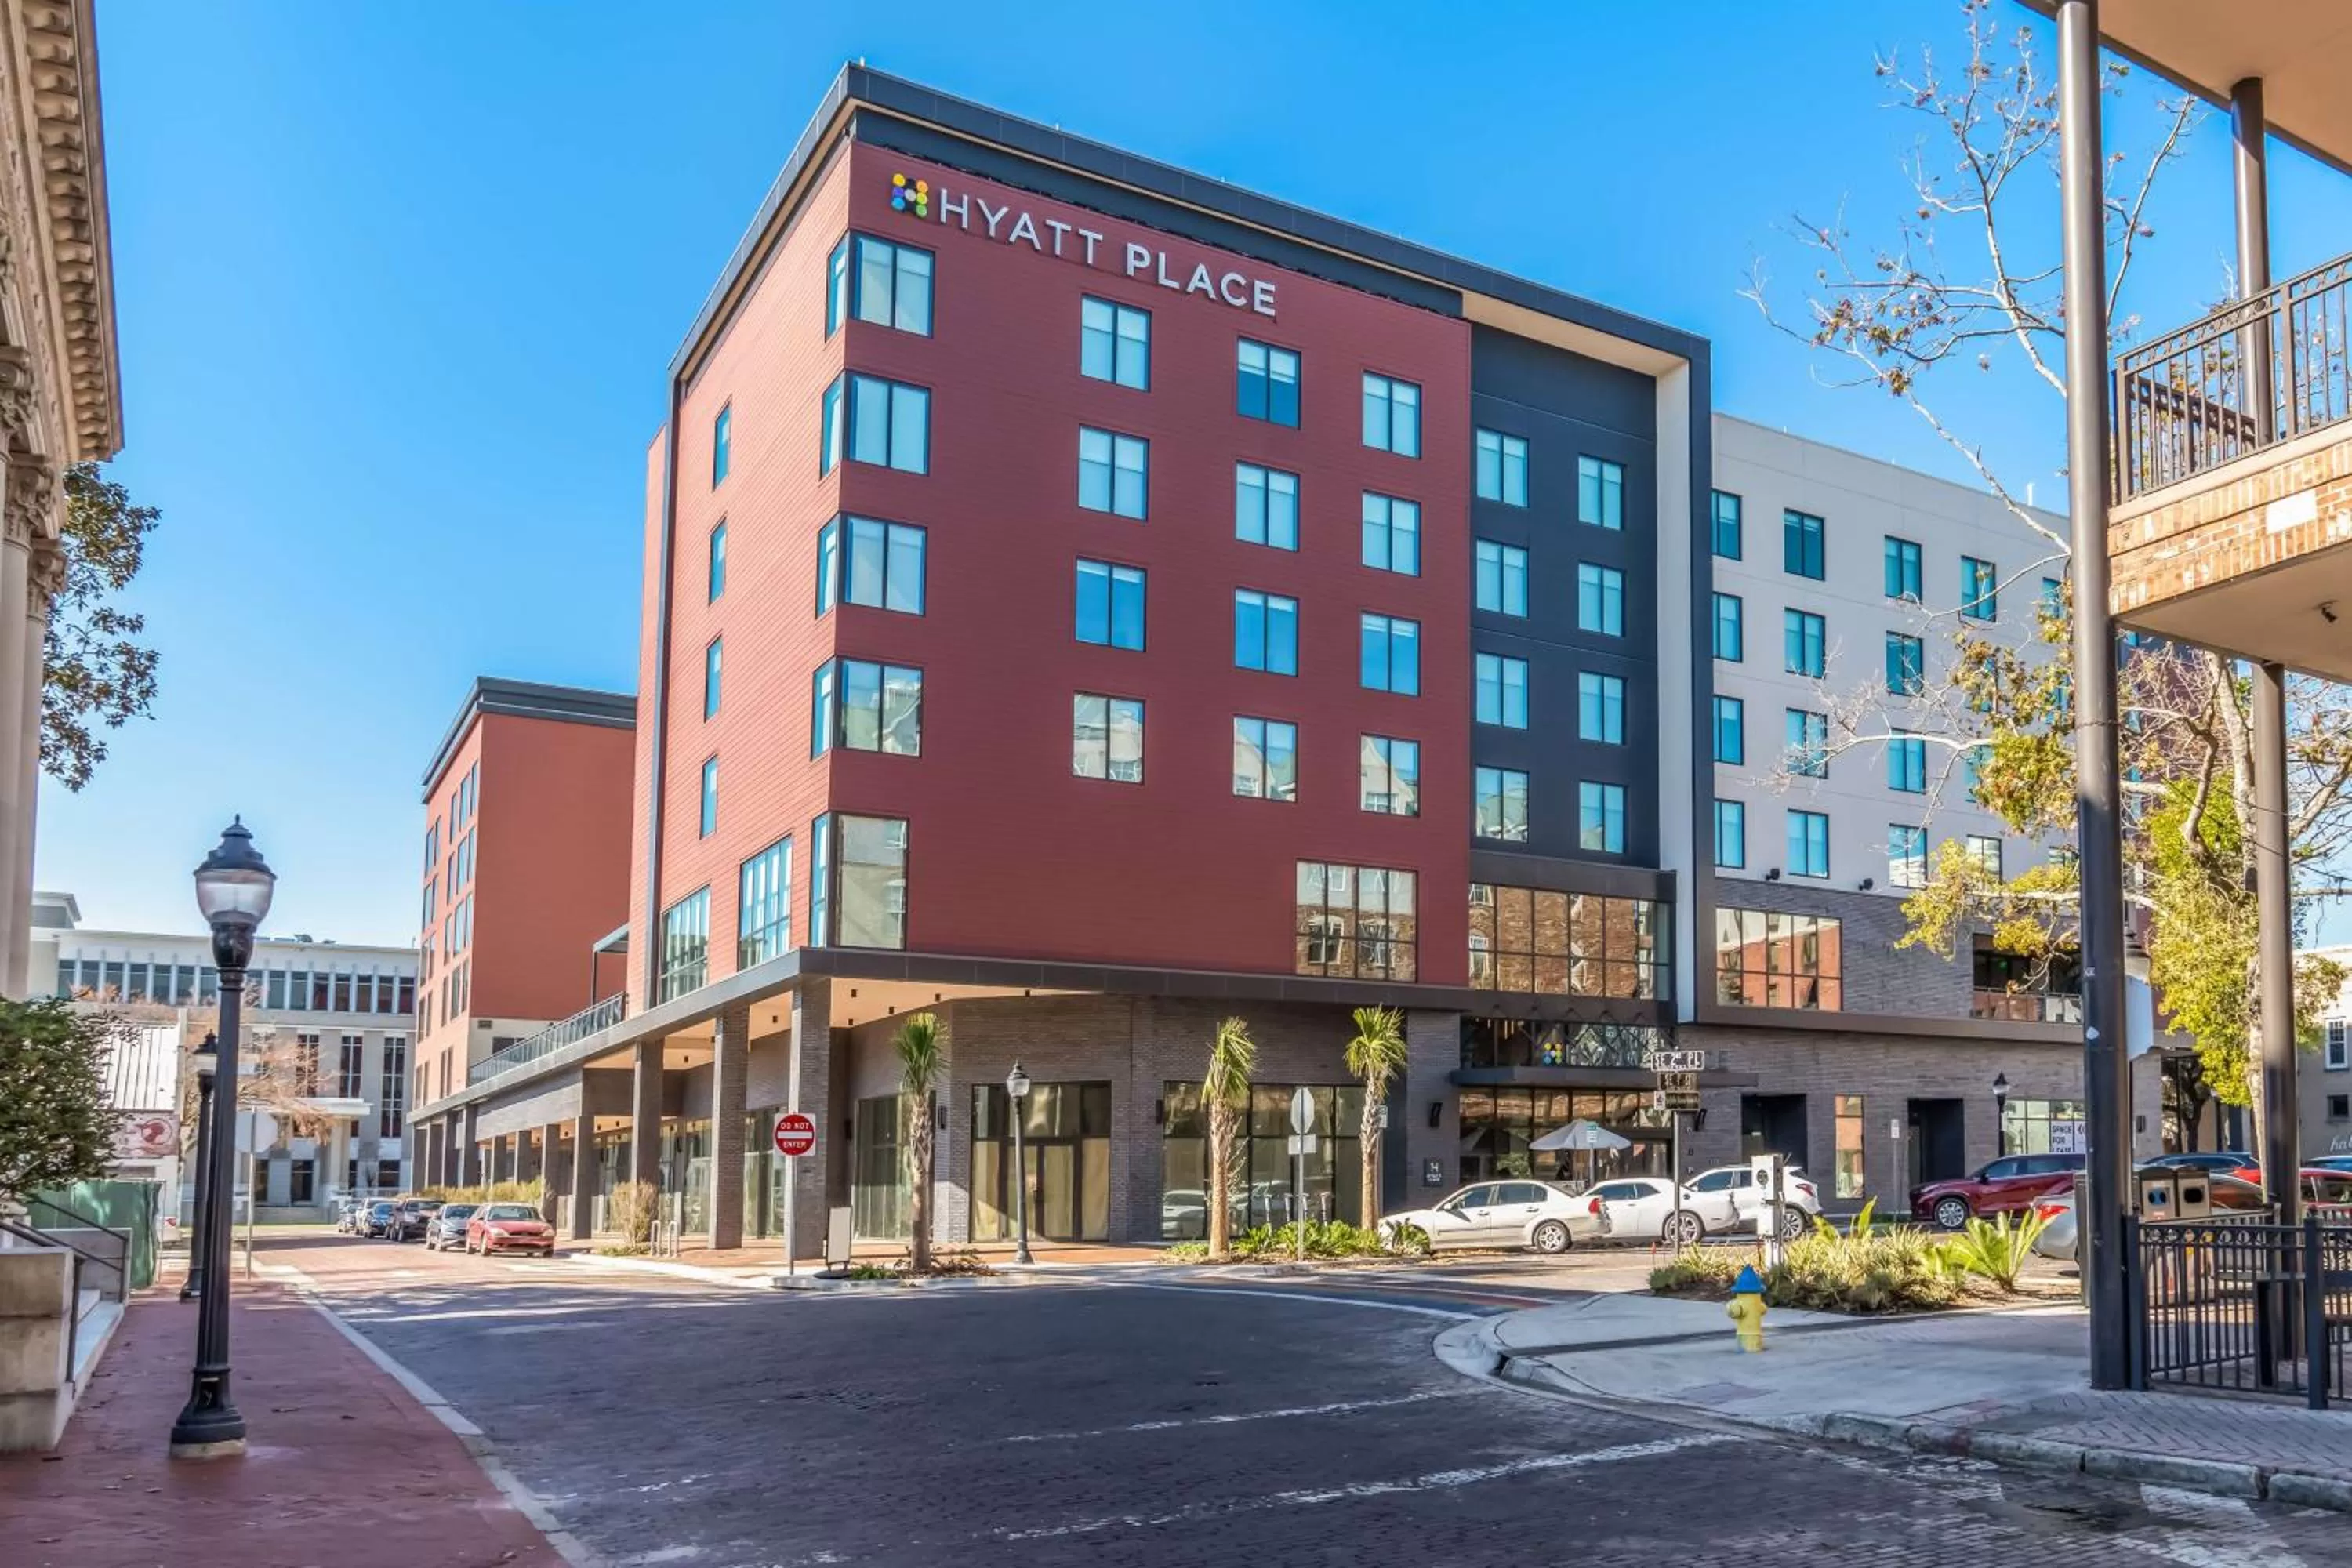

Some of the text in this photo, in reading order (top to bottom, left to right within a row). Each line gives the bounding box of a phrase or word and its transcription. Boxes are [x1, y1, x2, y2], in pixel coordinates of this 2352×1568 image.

[940, 187, 1276, 317] HYATT PLACE
[2052, 1125, 2072, 1134] SPACE
